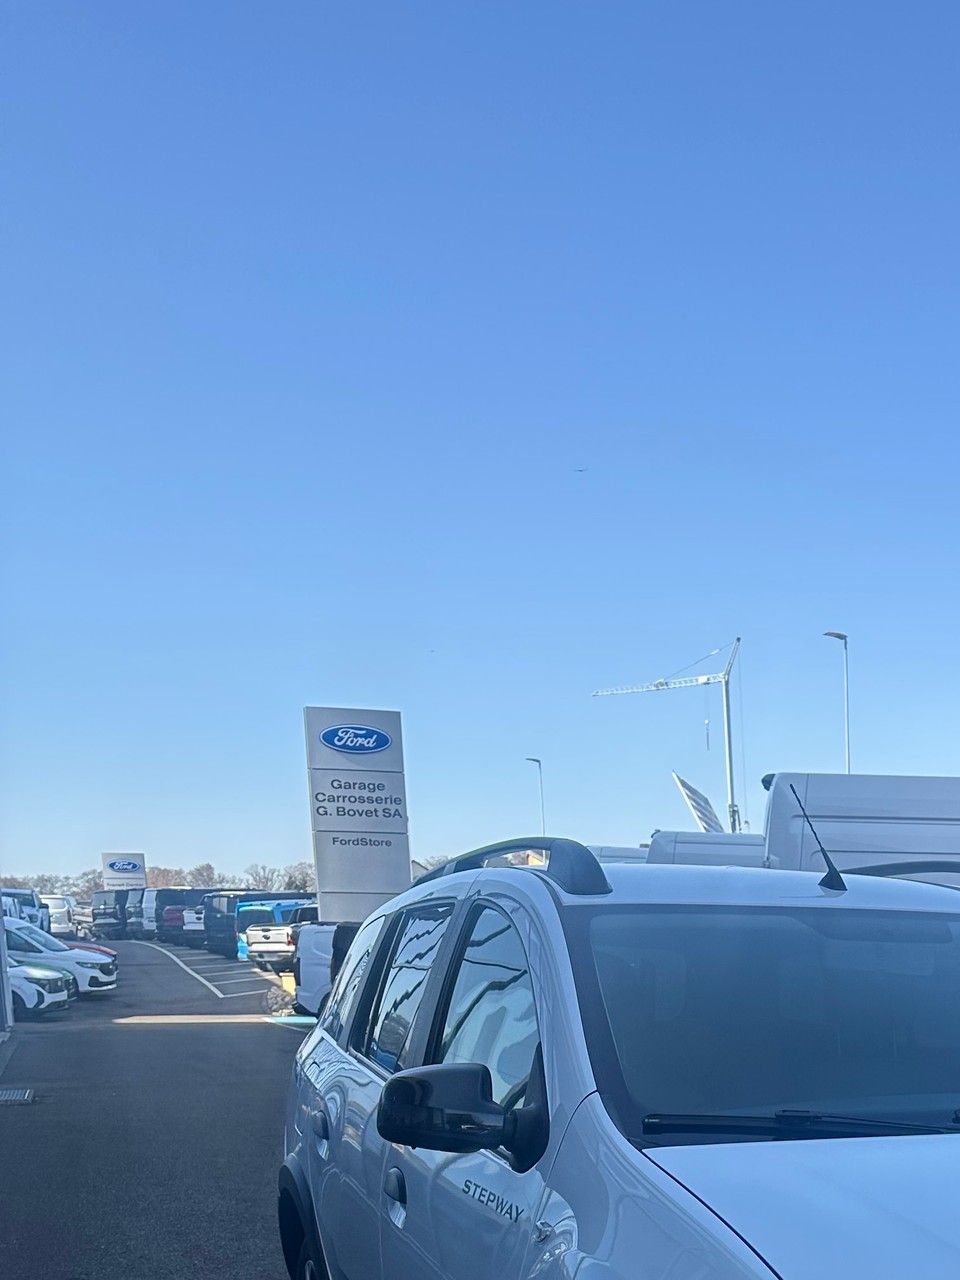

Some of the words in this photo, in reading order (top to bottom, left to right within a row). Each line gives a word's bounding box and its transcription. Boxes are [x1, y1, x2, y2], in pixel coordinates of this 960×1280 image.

[334, 728, 377, 747] Ford
[330, 779, 386, 793] Garage
[314, 792, 402, 805] Carrosserie
[316, 806, 333, 817] G.
[336, 806, 379, 818] Bovet
[382, 808, 403, 819] SA
[332, 836, 392, 847] FordStore
[462, 1179, 525, 1223] STEPWAY
